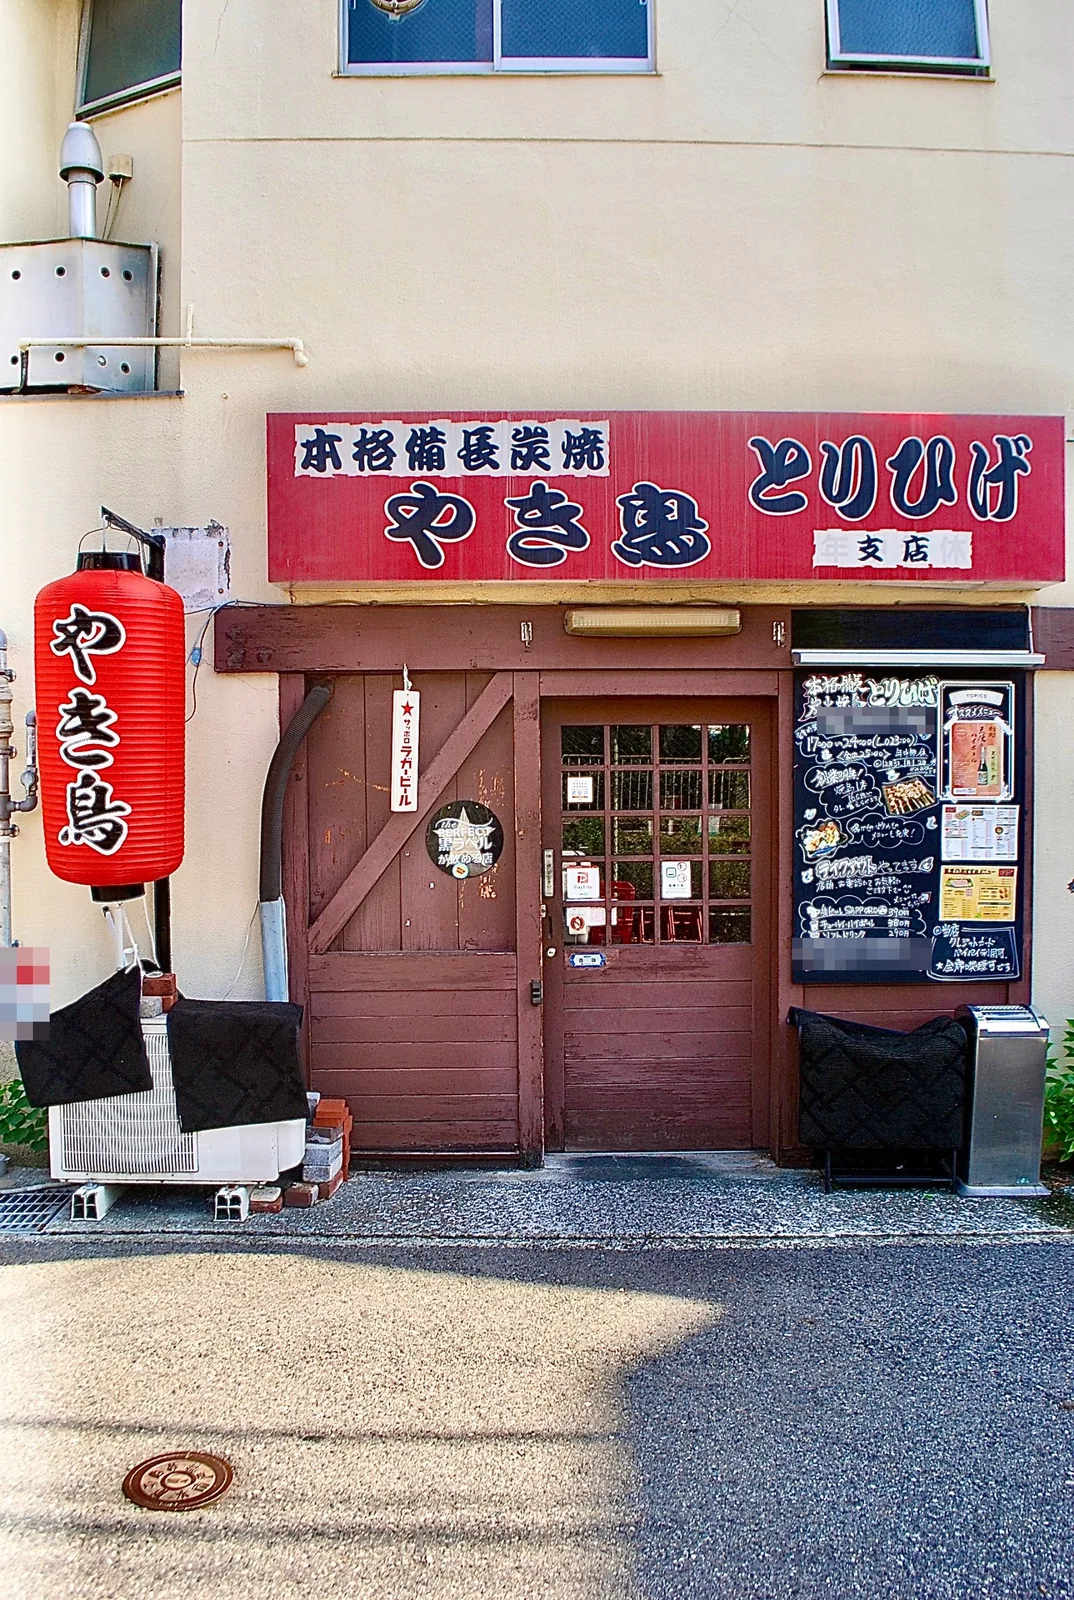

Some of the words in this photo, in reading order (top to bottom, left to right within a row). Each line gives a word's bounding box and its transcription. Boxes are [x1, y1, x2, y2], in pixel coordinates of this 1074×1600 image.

[300, 426, 603, 472] 本格備長炭焼
[747, 434, 1033, 522] とりひげ
[384, 480, 711, 569] やき鳥
[857, 535, 930, 562] 支店
[865, 677, 939, 709] とりひげ
[50, 603, 132, 856] やき鳥
[438, 826, 492, 838] PERFECT
[438, 836, 493, 852] 黒ラベル
